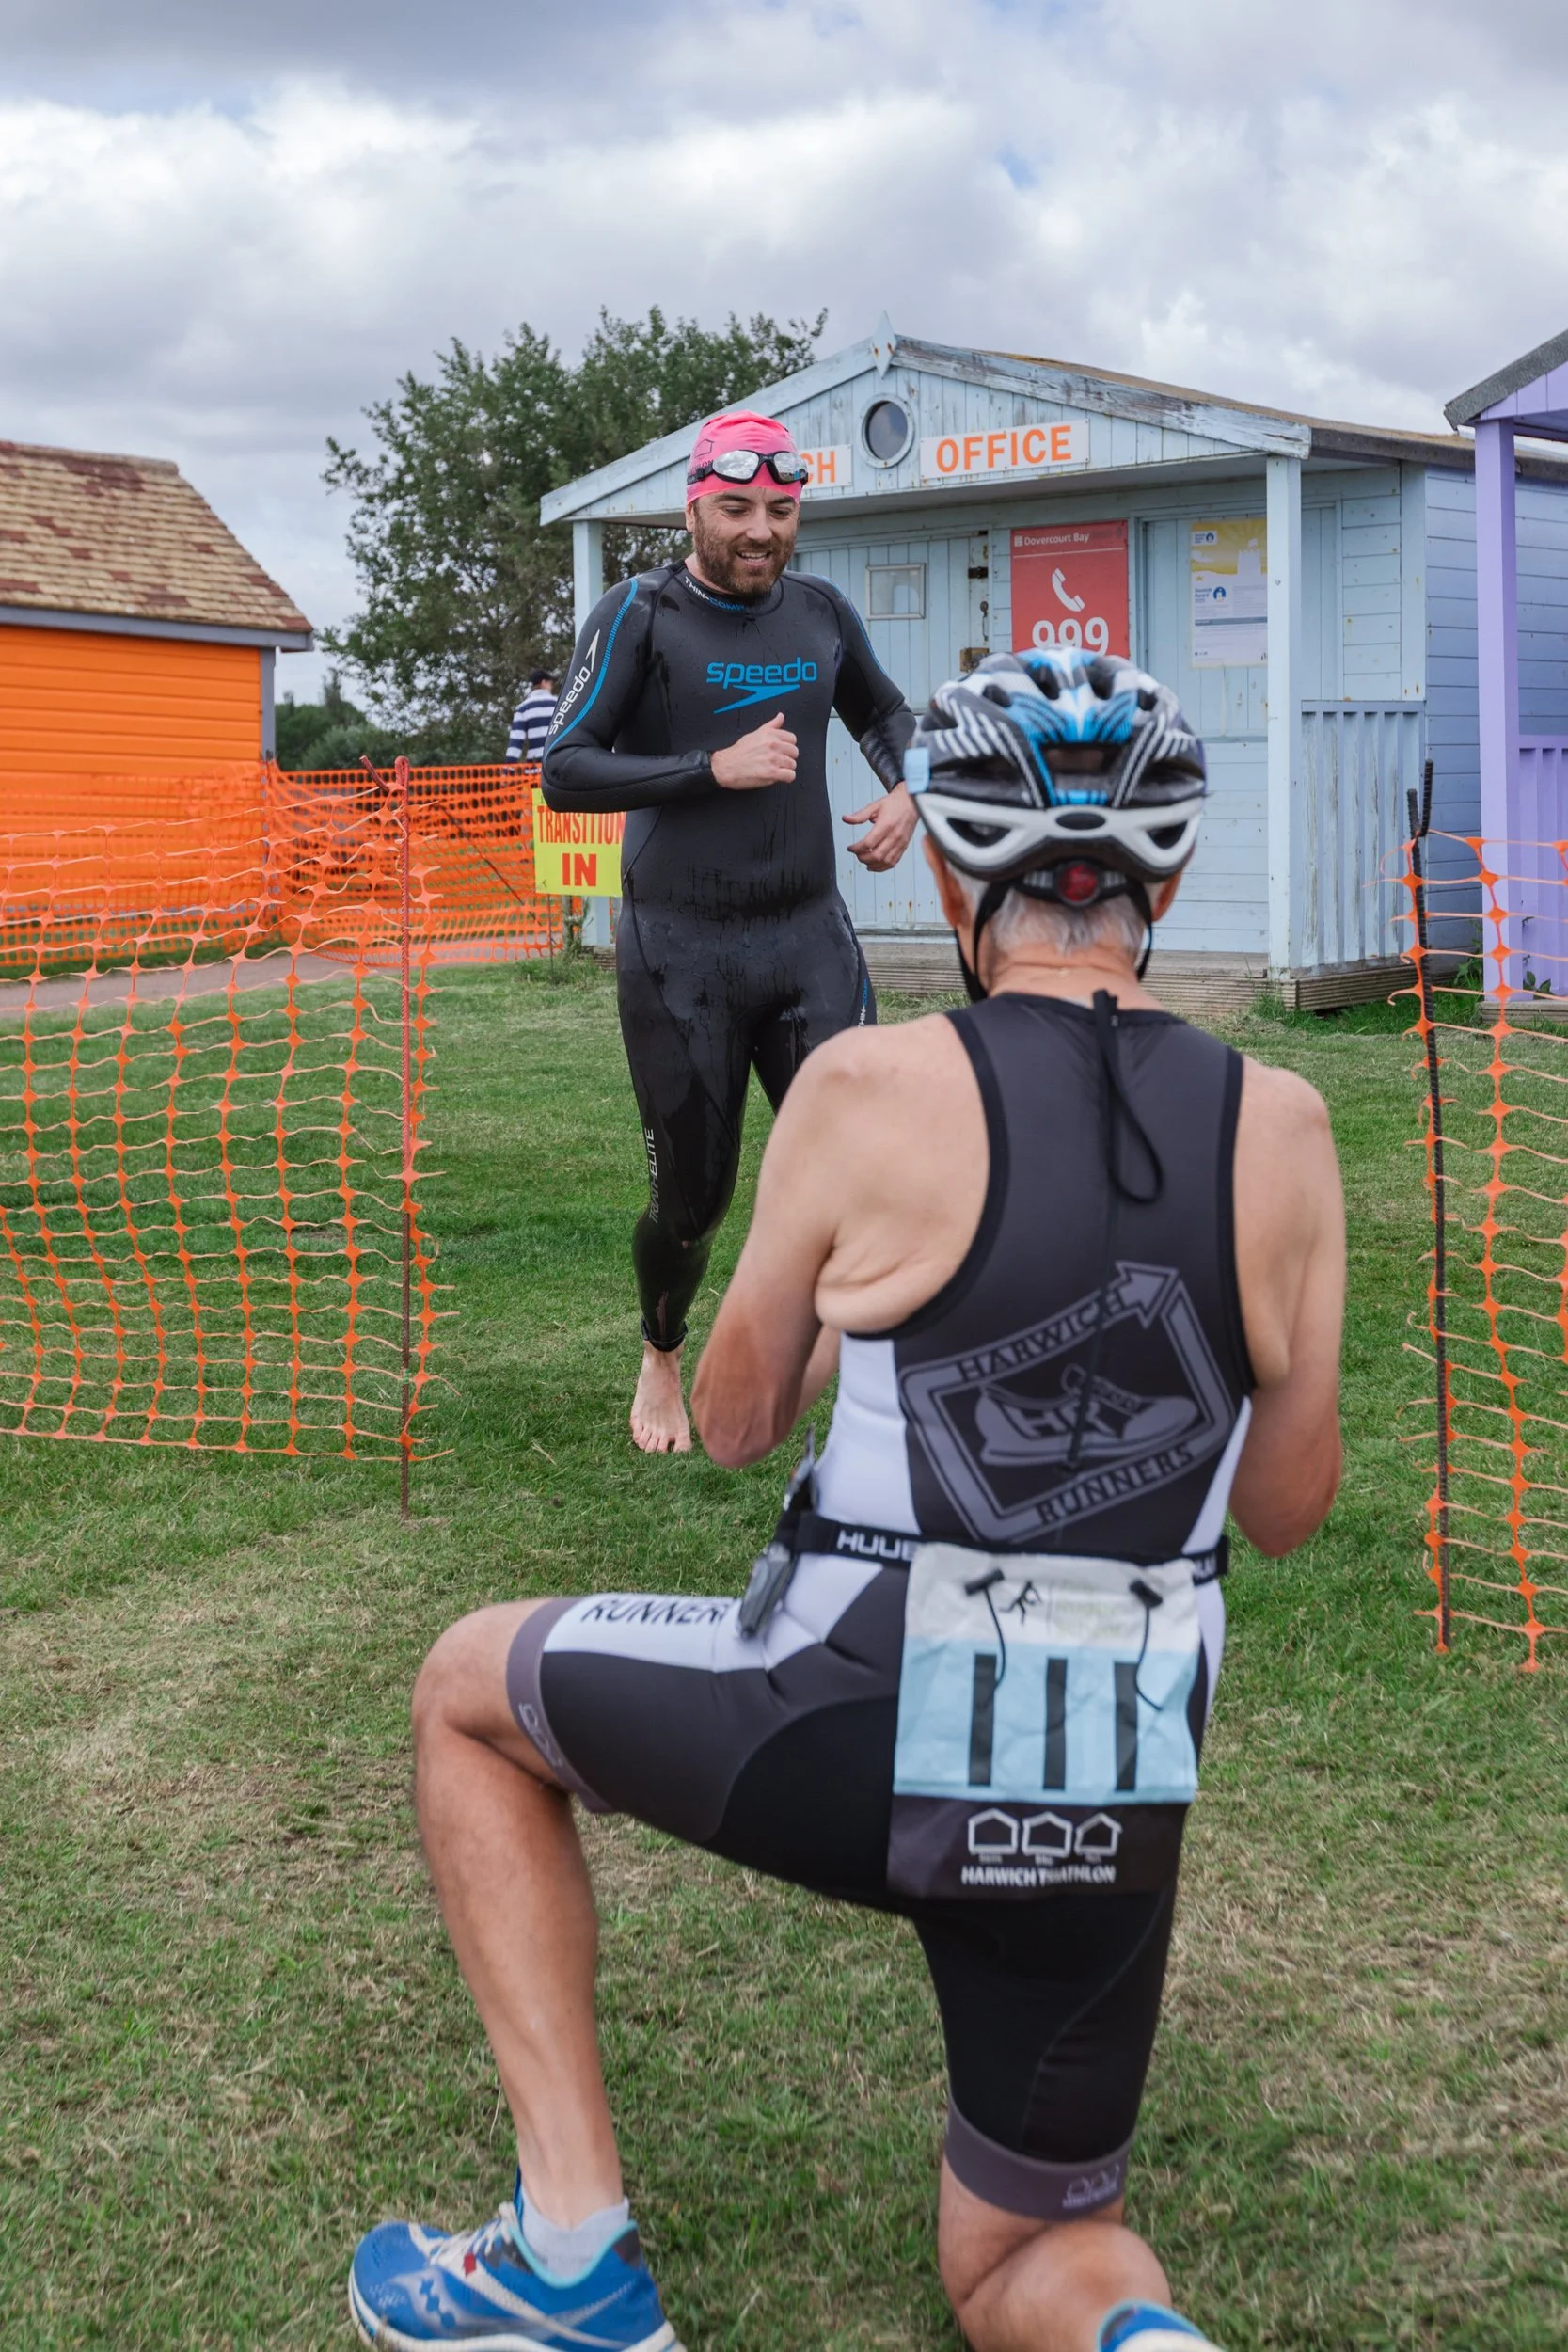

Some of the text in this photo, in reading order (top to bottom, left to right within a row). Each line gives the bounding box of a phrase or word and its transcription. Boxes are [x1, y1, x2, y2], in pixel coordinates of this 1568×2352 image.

[936, 425, 1071, 473] OFFICE
[1024, 533, 1071, 546] Dovercourt
[1073, 532, 1089, 543] Bay
[1032, 616, 1109, 658] 999
[706, 656, 817, 690] speedo
[548, 666, 591, 735] speedo
[562, 852, 597, 887] IN
[956, 1288, 1126, 1383] HARWICH
[1037, 1443, 1193, 1524] RUNNERS
[961, 1865, 1036, 1887] HARWICH
